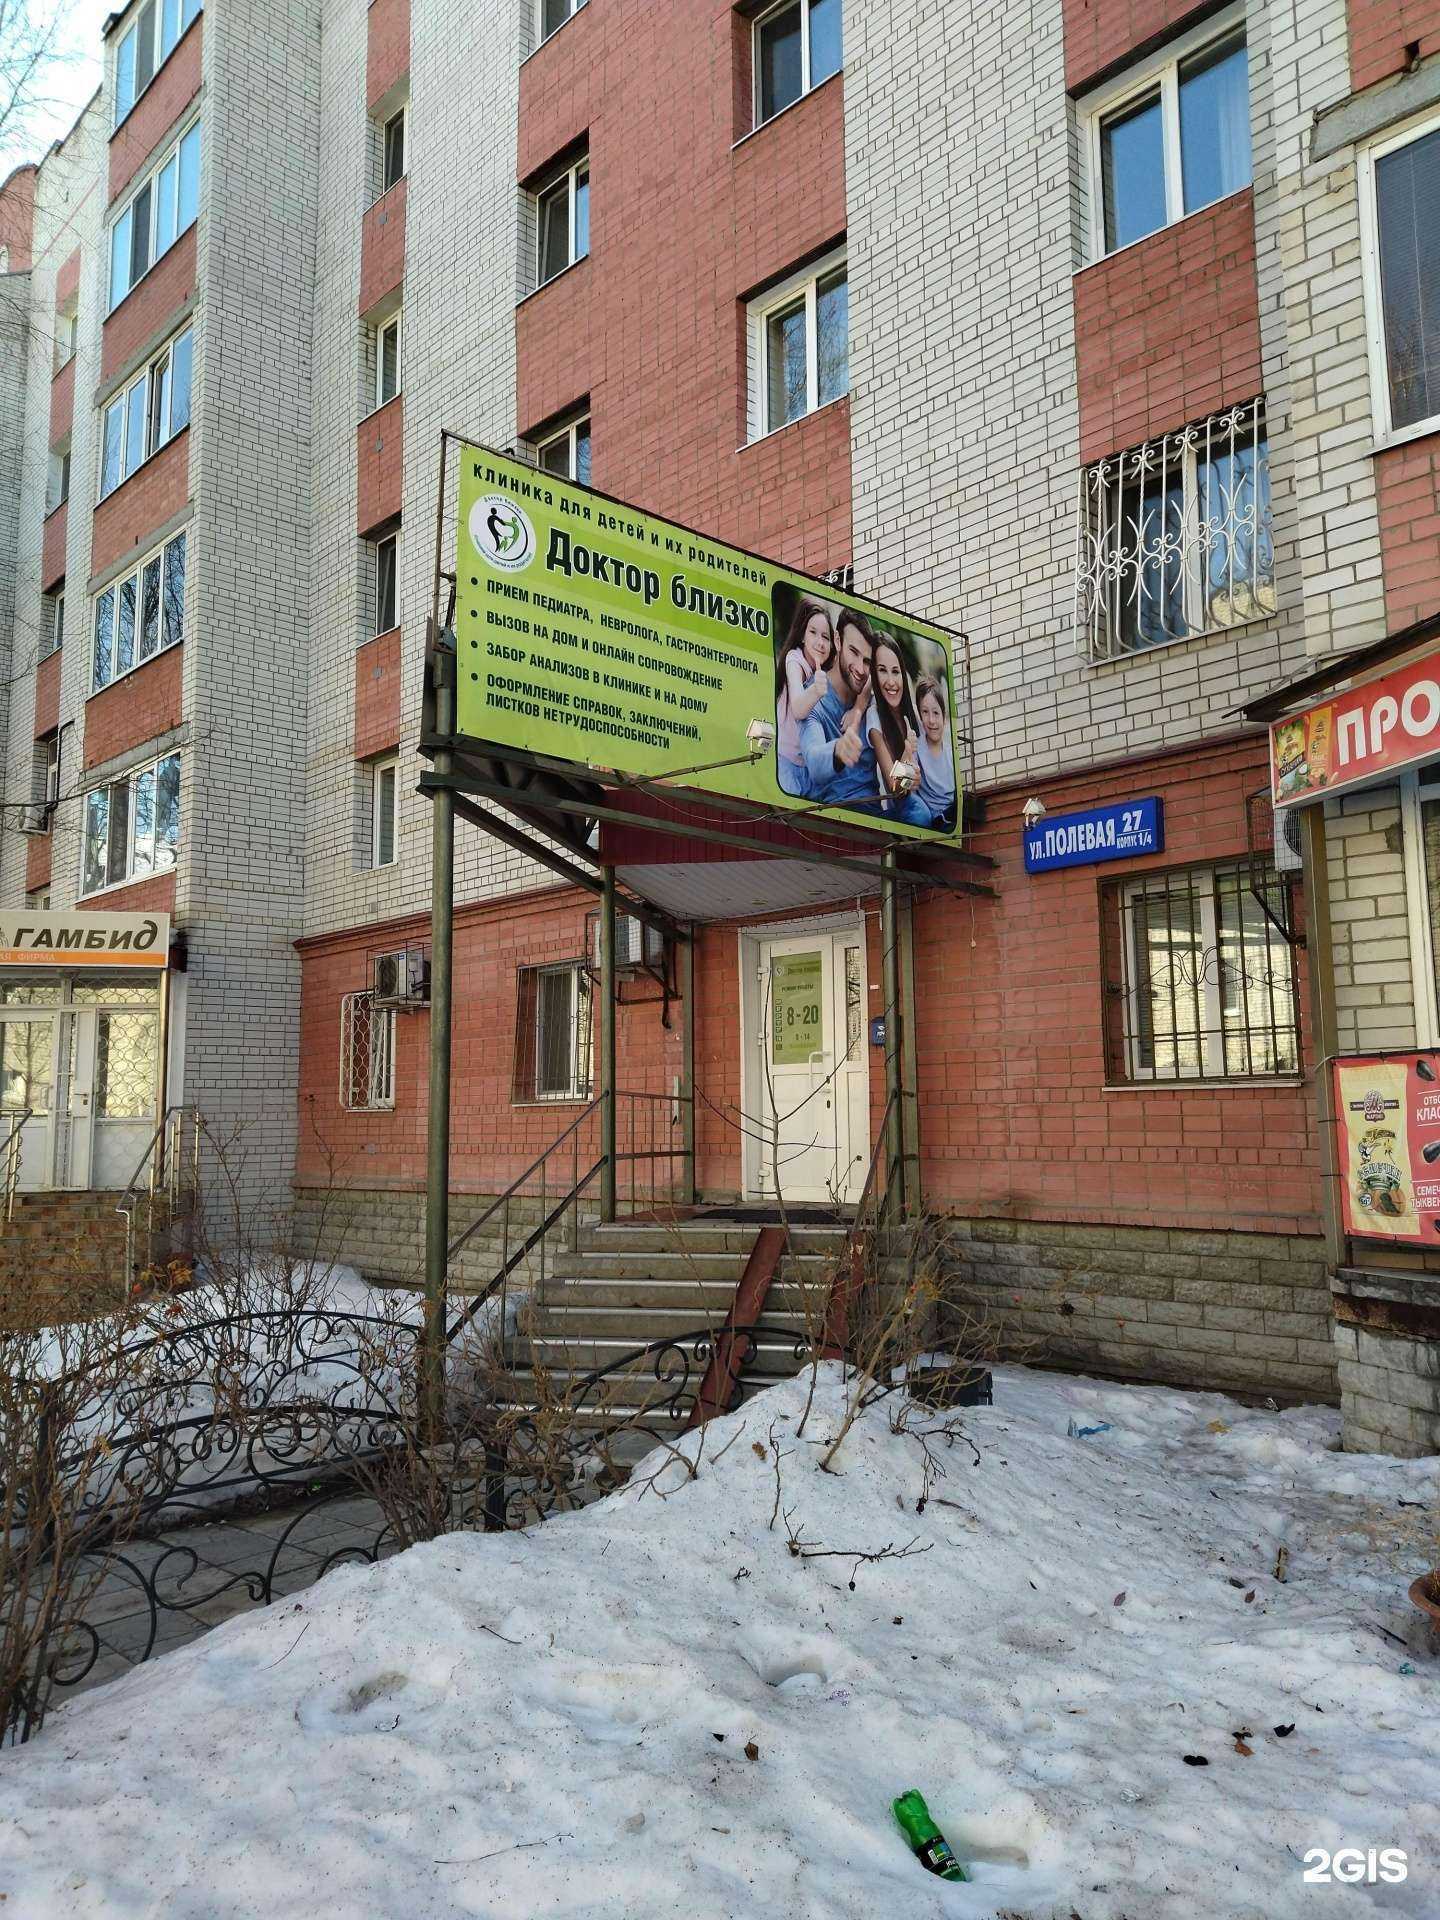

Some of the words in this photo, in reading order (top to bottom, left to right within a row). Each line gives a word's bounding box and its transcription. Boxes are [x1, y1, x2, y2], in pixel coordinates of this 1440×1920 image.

[473, 463, 553, 506] клиника
[560, 497, 591, 520] для
[597, 511, 645, 541] детей
[651, 534, 659, 547] и
[665, 538, 683, 555] их
[688, 545, 767, 587] родителей
[546, 526, 660, 606] Доктор
[670, 573, 770, 638] близко
[486, 610, 530, 634] ВЫЗОВ
[533, 623, 549, 640] НА
[552, 629, 578, 648] ДОМ
[581, 637, 589, 651] И
[592, 641, 635, 665] ОНЛАЙН
[637, 654, 723, 690] СОПРОВОЖДЕНИЕ
[487, 579, 529, 603] ПРИЕМ
[532, 592, 594, 625] ПЕДИАТРА,
[600, 613, 663, 646] НЕВРОЛОГА,
[665, 634, 759, 675] ГАСТРОЭНТЕРОЛОГА
[486, 642, 526, 663] ЗАБОР
[529, 653, 590, 681] АНАЛИЗОВ
[592, 670, 600, 684] В
[603, 674, 651, 699] КЛИНИКЕ
[654, 688, 661, 701] И
[664, 690, 677, 706] НА
[680, 695, 708, 714] ДОМУ
[487, 673, 570, 707] ОФОРМЛЕНИЕ
[573, 695, 626, 722] СПРАВОК,
[629, 710, 702, 742] ЗАКЛЮЧЕНИЙ,
[486, 692, 540, 718] ЛИСТКОВ
[543, 706, 670, 749] НЕТРУДОСПОСОБНОСТИ
[1336, 679, 1440, 767] ПРО
[1122, 809, 1143, 833] 27
[1138, 832, 1152, 848] 1/4
[17, 951, 56, 961] ФИРМА
